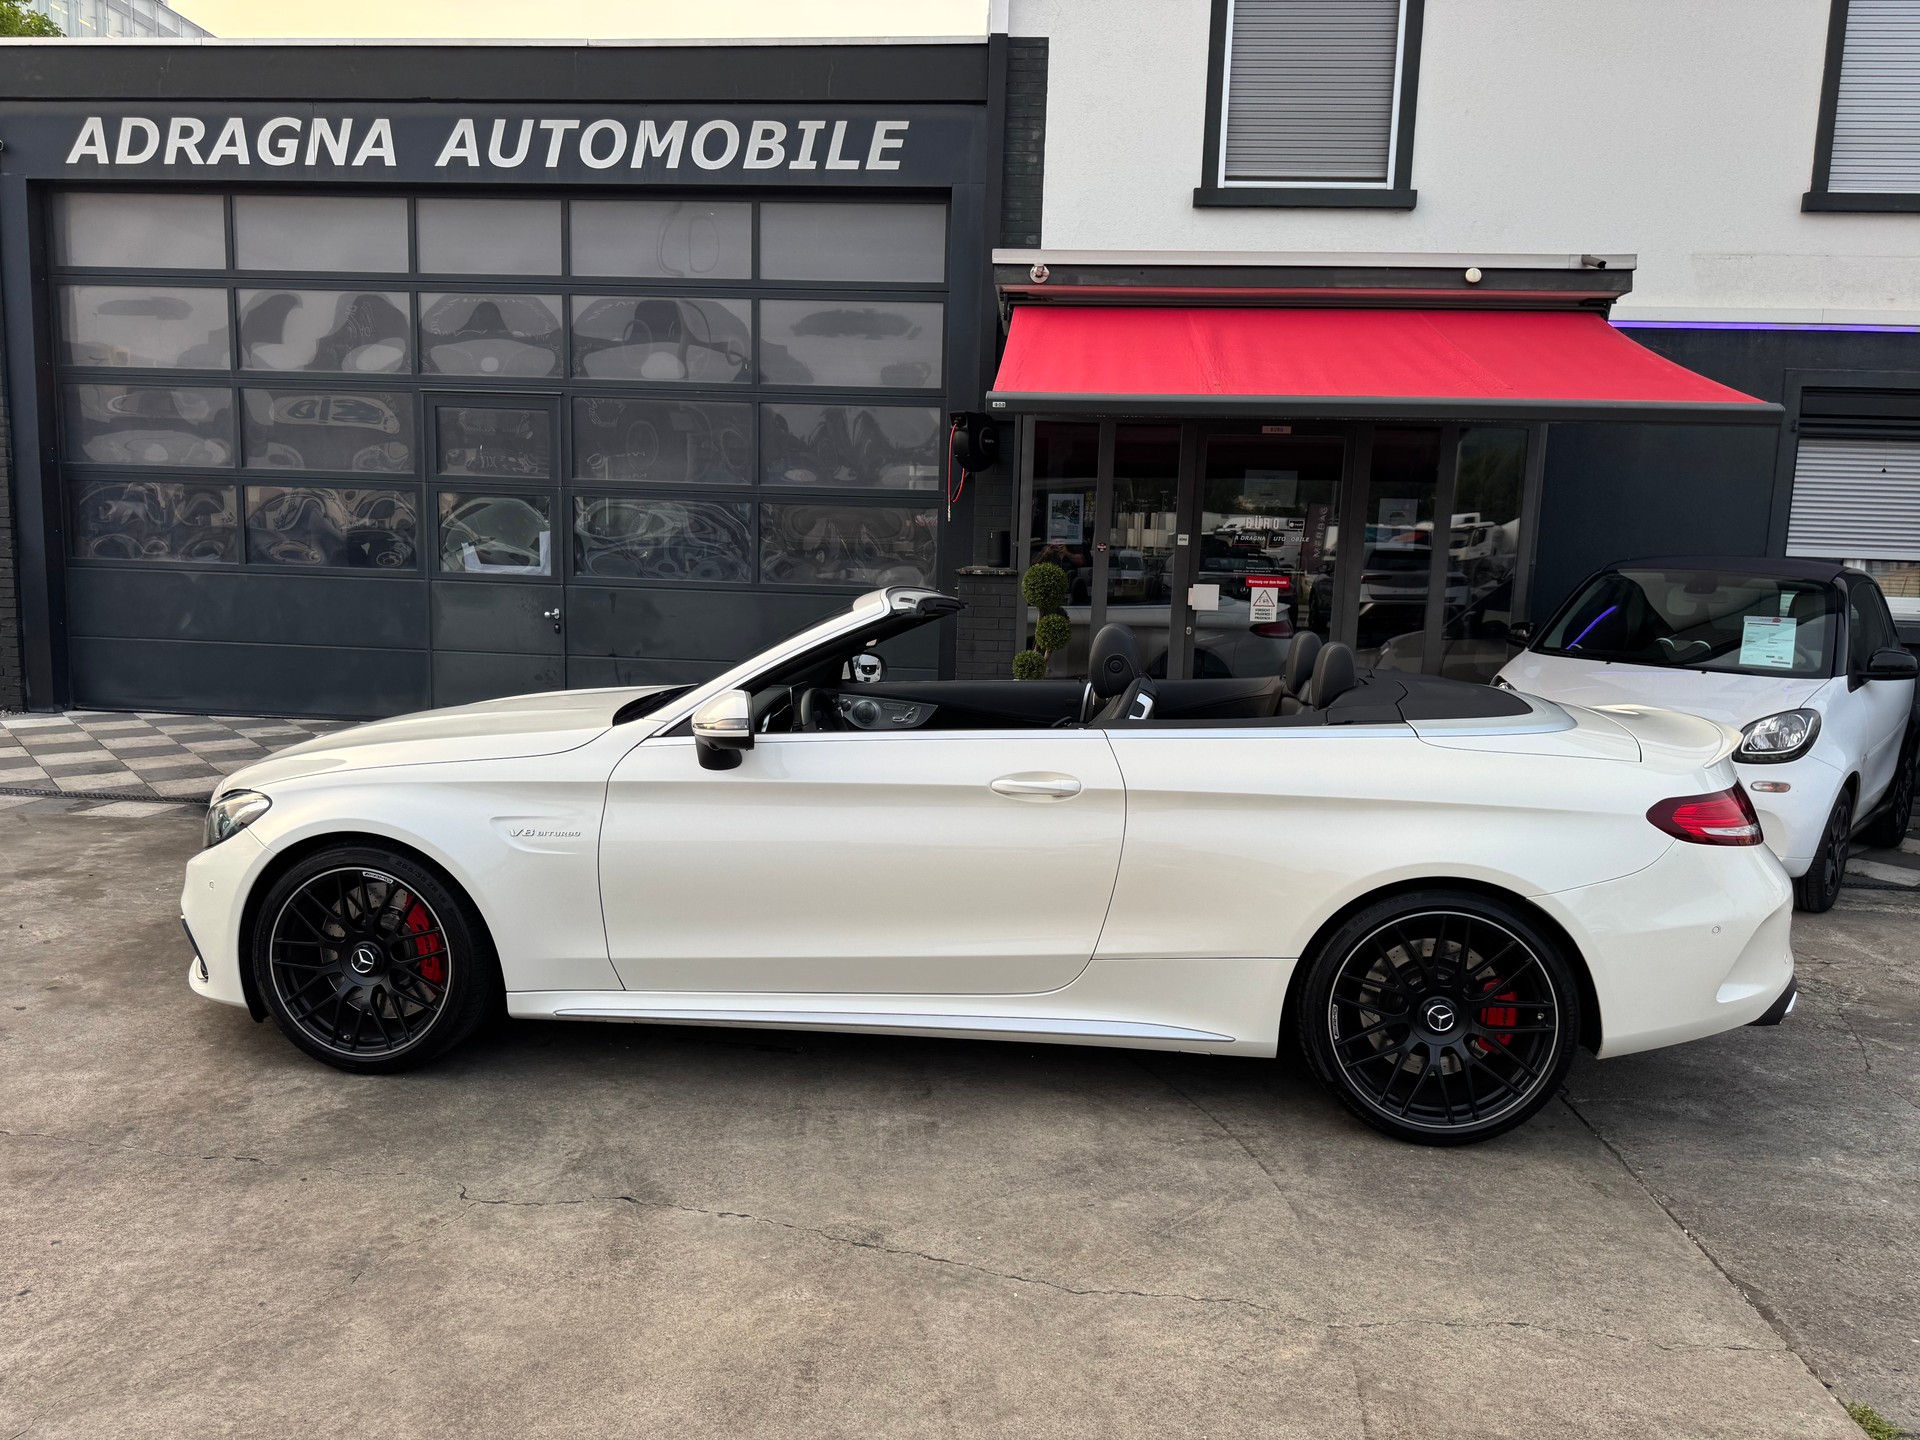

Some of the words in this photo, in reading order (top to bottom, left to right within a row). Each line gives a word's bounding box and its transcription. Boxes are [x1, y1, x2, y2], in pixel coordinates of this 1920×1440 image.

[65, 116, 397, 167] ADRAGNA
[434, 118, 910, 170] AUTOMOBILE
[1245, 515, 1280, 529] BÜRO
[1312, 506, 1329, 558] MERBAG
[509, 828, 535, 837] V8
